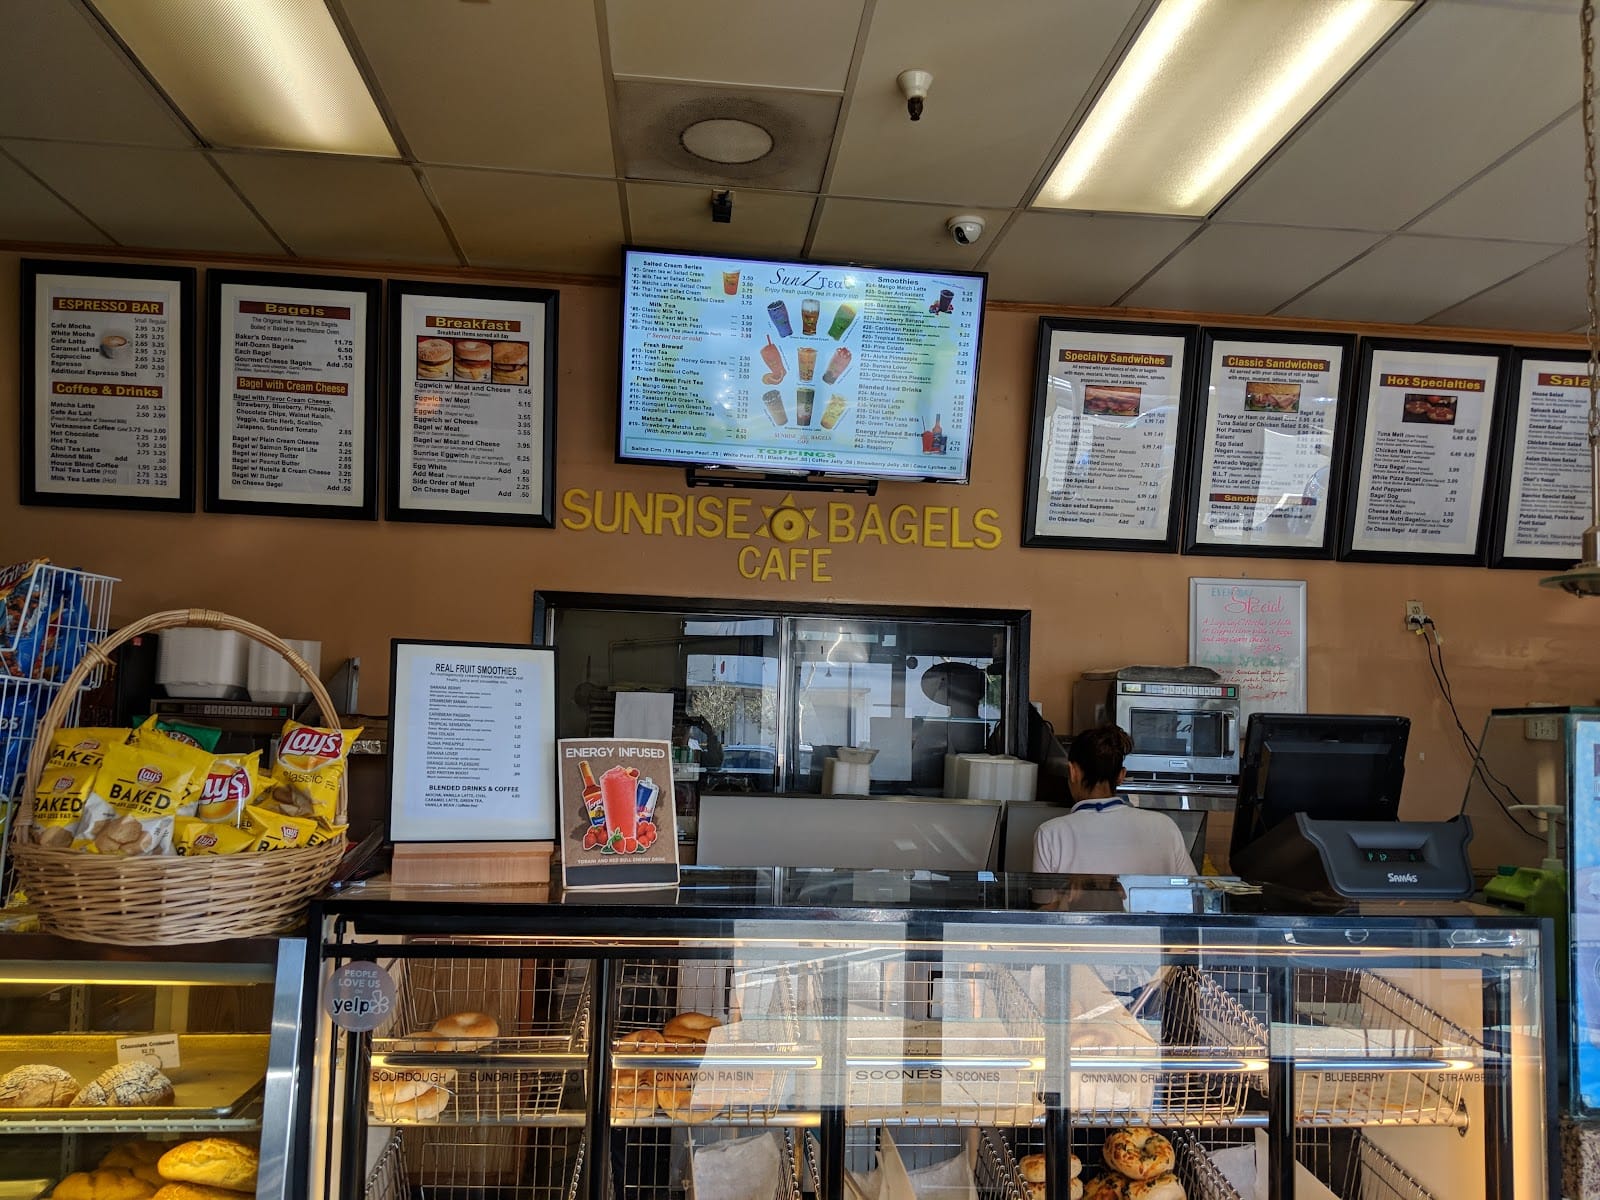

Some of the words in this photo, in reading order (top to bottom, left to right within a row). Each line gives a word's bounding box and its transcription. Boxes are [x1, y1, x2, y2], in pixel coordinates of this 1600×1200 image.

[878, 277, 918, 285] Smoothies
[59, 299, 127, 312] ESPRESSO
[132, 303, 159, 313] BAR
[266, 304, 325, 316] Bagels
[435, 317, 511, 330] Breakfast
[1064, 351, 1108, 364] Specialty
[1110, 354, 1165, 365] Sandwiches
[1228, 358, 1264, 368] Classic
[1266, 360, 1324, 369] Sandwiches
[240, 378, 263, 389] Bagel
[266, 380, 283, 389] with
[287, 381, 313, 392] Cream
[315, 383, 346, 393] Cheese
[1387, 376, 1410, 386] Hot
[1412, 378, 1481, 390] Specialties
[1550, 376, 1590, 386] Sala
[57, 384, 98, 394] Coffee
[102, 386, 111, 395] &
[116, 387, 158, 397] Drinks
[757, 449, 836, 458] TOPPINGS
[561, 488, 753, 540] SUNRISE
[828, 502, 1002, 551] BAGELS
[737, 545, 833, 583] CAFE
[436, 664, 454, 673] REAL
[456, 664, 476, 674] FRUIT
[477, 666, 517, 676] SMOOTHIES
[281, 729, 341, 756] Lay's
[52, 750, 103, 768] AKE
[566, 748, 615, 758] ENERGY
[619, 748, 665, 758] INFUSED
[138, 768, 162, 783] Lay's
[202, 773, 244, 805] ay's
[110, 784, 170, 810] BAKED
[33, 797, 82, 812] BAKED
[333, 996, 370, 1016] yelp
[372, 1072, 446, 1082] SOURDOUGH
[470, 1072, 528, 1081] SUNDRIED
[656, 1072, 714, 1082] CINNAMON
[718, 1072, 754, 1081] RAISIN
[855, 1070, 942, 1080] SCONES
[956, 1072, 1000, 1082] SCONES
[1081, 1073, 1137, 1083] CINNAMON
[1140, 1073, 1186, 1083] CRUNCH
[1325, 1073, 1384, 1082] BLUEBERRY
[1438, 1073, 1509, 1082] STRAWBE
